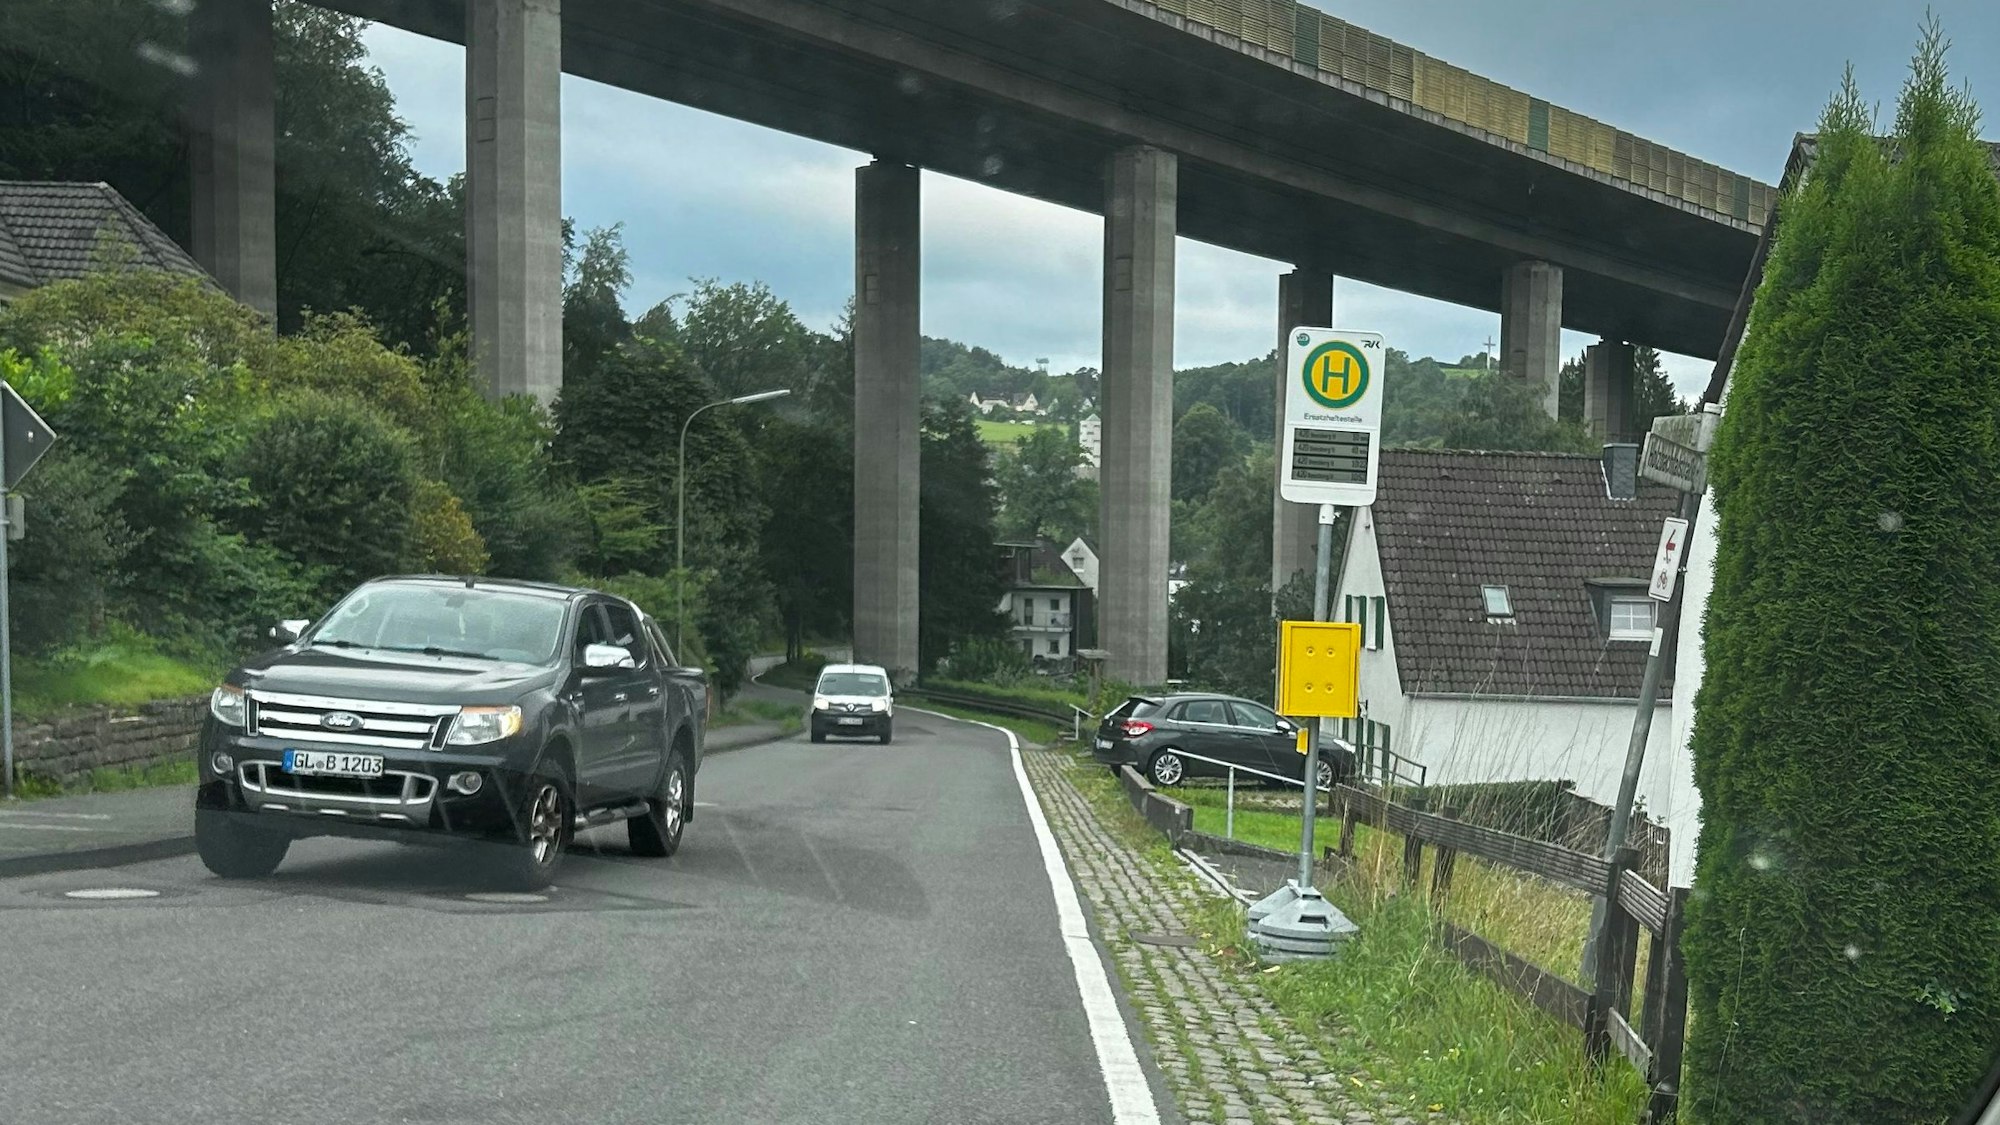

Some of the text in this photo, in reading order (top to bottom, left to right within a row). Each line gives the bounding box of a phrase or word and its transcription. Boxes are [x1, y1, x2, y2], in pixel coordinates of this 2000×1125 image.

[1322, 356, 1350, 394] H
[294, 753, 314, 769] GL
[326, 755, 336, 770] B
[341, 757, 381, 773] 1203
